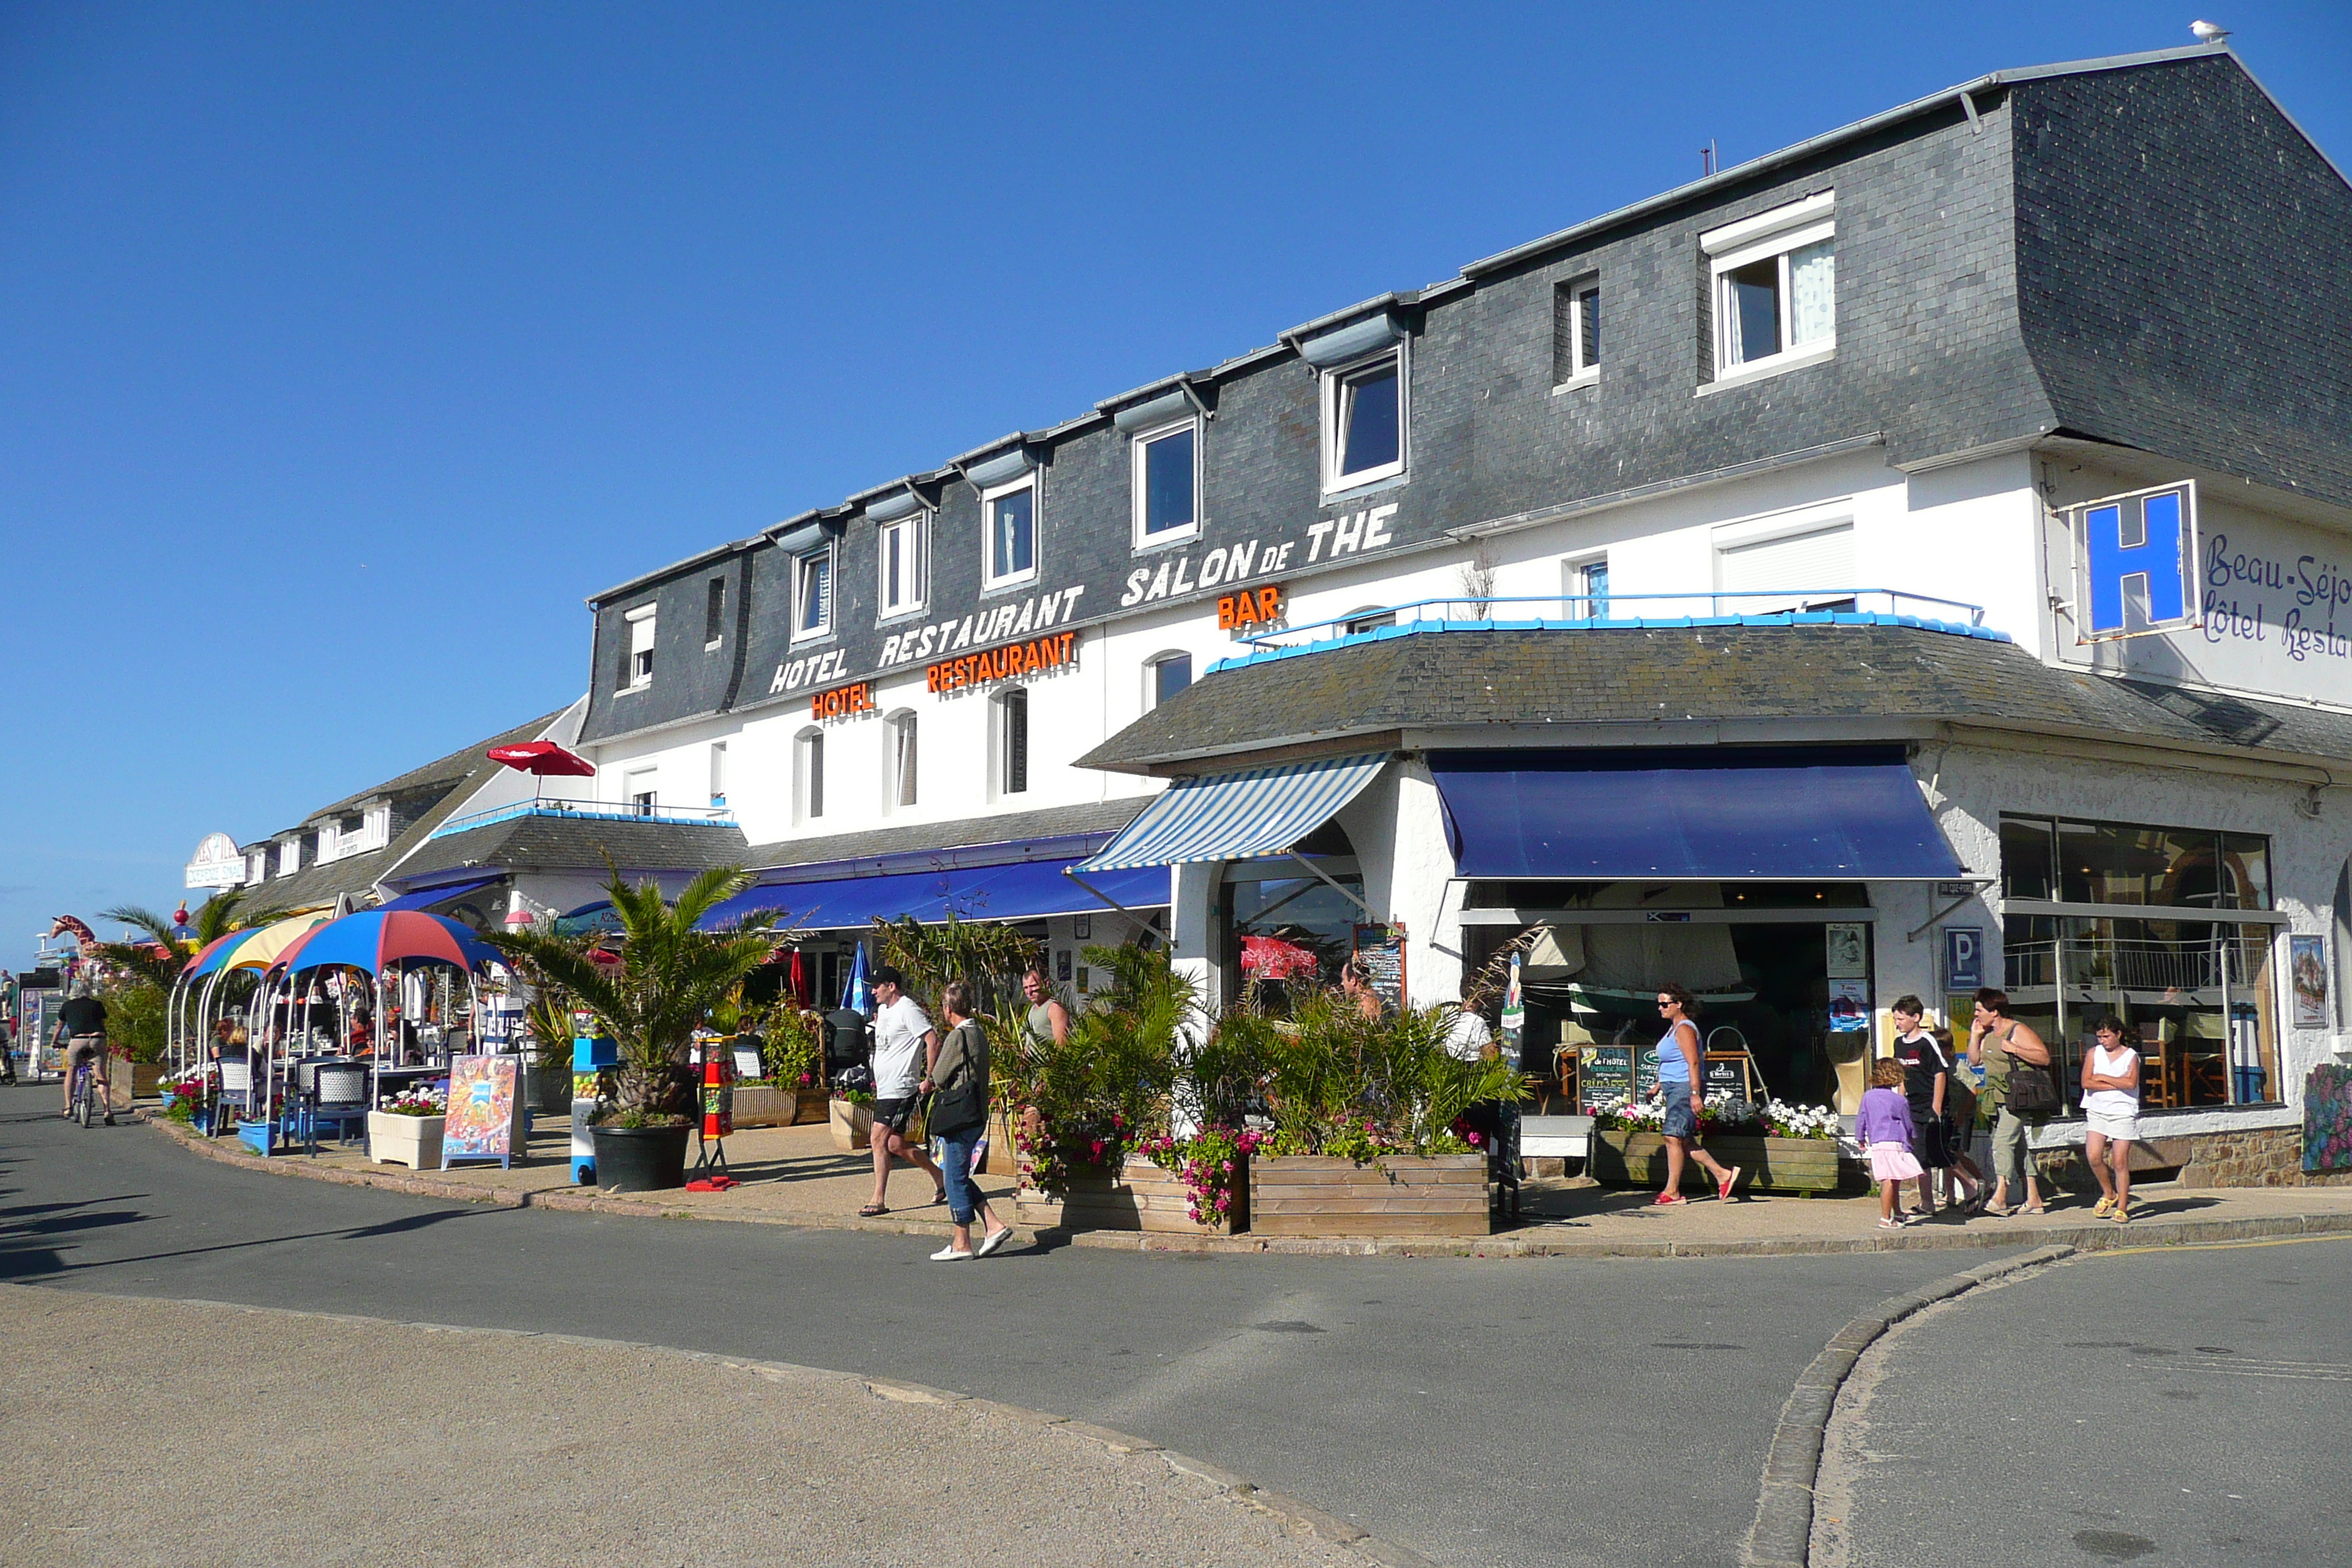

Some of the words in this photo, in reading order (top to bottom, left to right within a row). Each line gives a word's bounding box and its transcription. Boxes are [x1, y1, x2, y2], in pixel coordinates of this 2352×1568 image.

[2084, 490, 2186, 635] H
[769, 648, 848, 695] HOTEL
[878, 584, 1085, 668] RESTAURANT
[1121, 539, 1259, 607] SALON
[1258, 541, 1294, 575] DE
[1307, 502, 1398, 562] THE
[1218, 587, 1278, 630] BAR
[2280, 608, 2352, 661] Resta
[927, 633, 1074, 693] RESTAURANT
[811, 683, 874, 721] HOTEL
[1955, 933, 1972, 971] P
